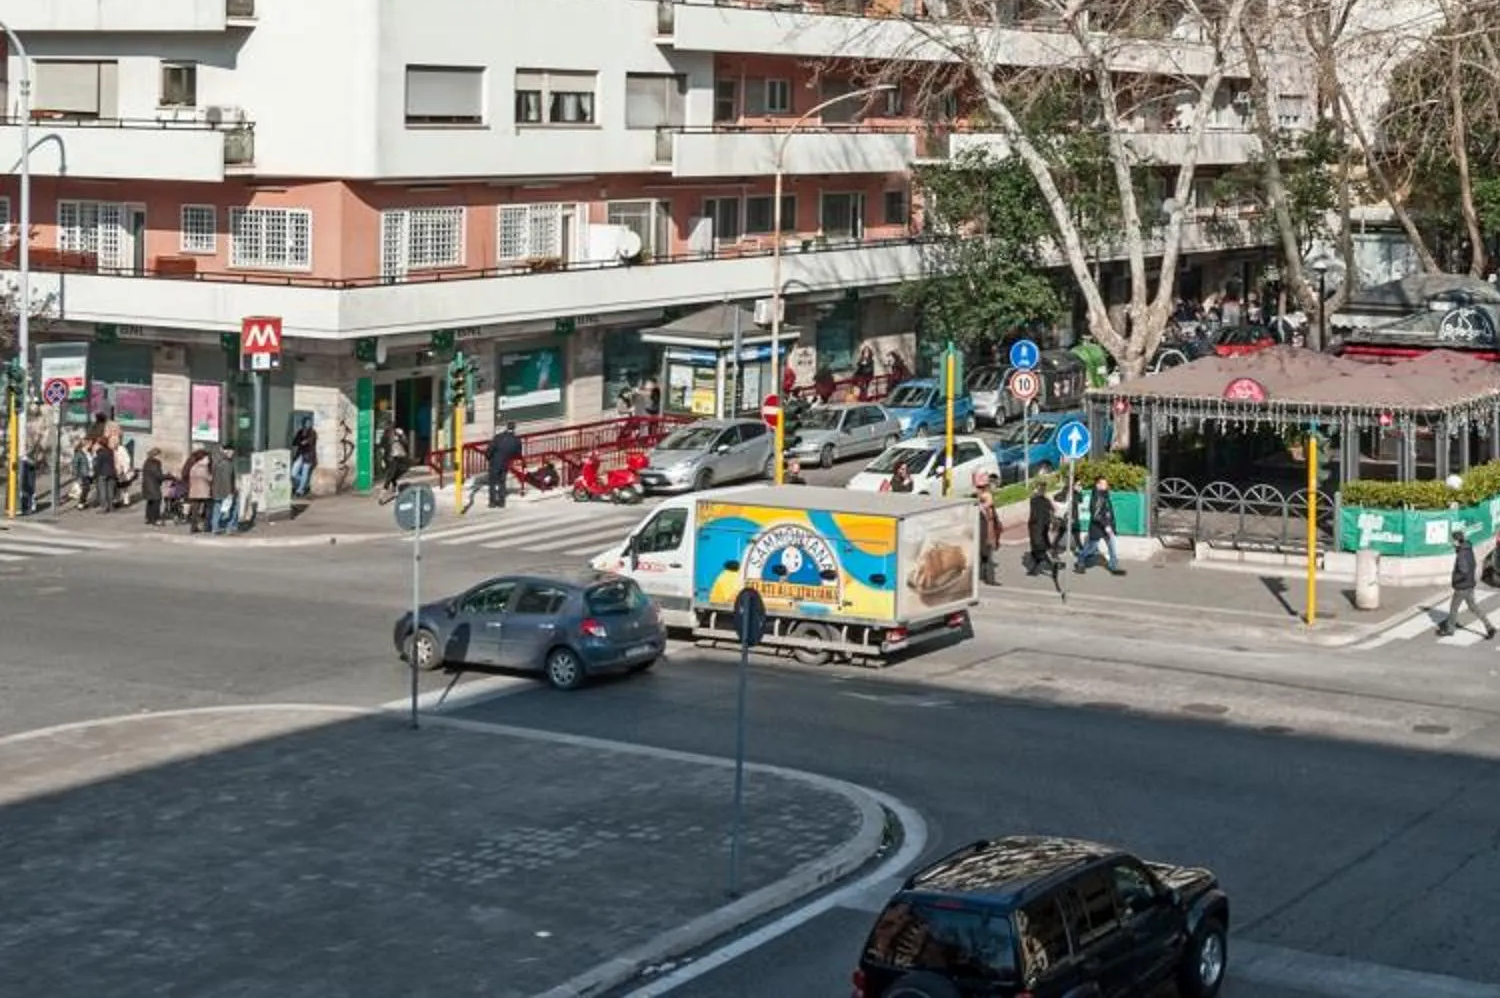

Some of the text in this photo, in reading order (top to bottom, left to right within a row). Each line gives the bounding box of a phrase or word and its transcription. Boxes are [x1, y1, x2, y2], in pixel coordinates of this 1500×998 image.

[245, 324, 279, 347] M
[1019, 377, 1031, 391] 10
[750, 527, 833, 571] SAMMONTANA
